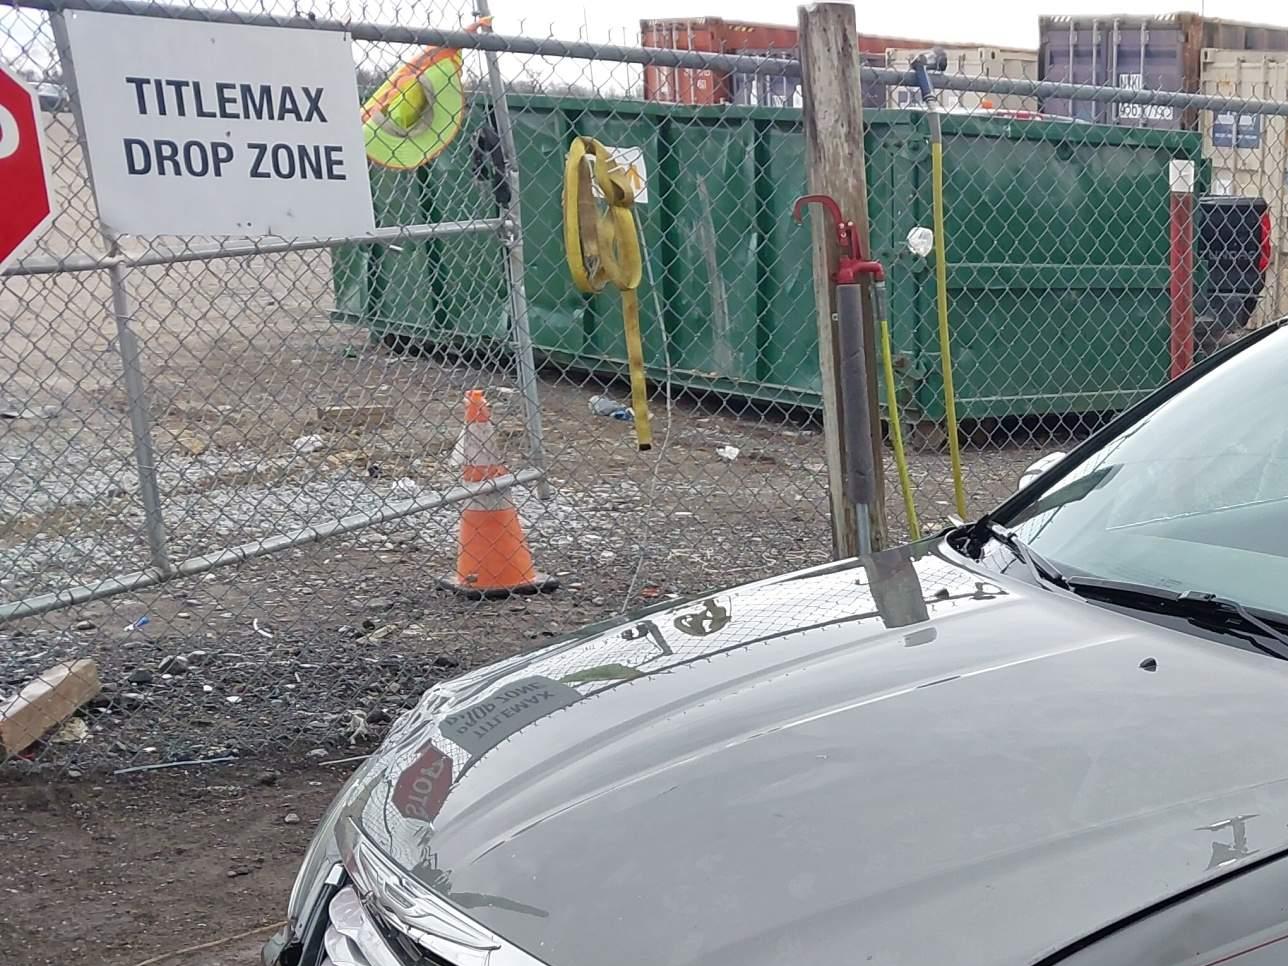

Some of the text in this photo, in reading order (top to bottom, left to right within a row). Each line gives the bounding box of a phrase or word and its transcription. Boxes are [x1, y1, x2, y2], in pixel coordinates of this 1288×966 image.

[126, 76, 328, 123] TITLEMAX
[123, 138, 348, 181] DROP ZONE
